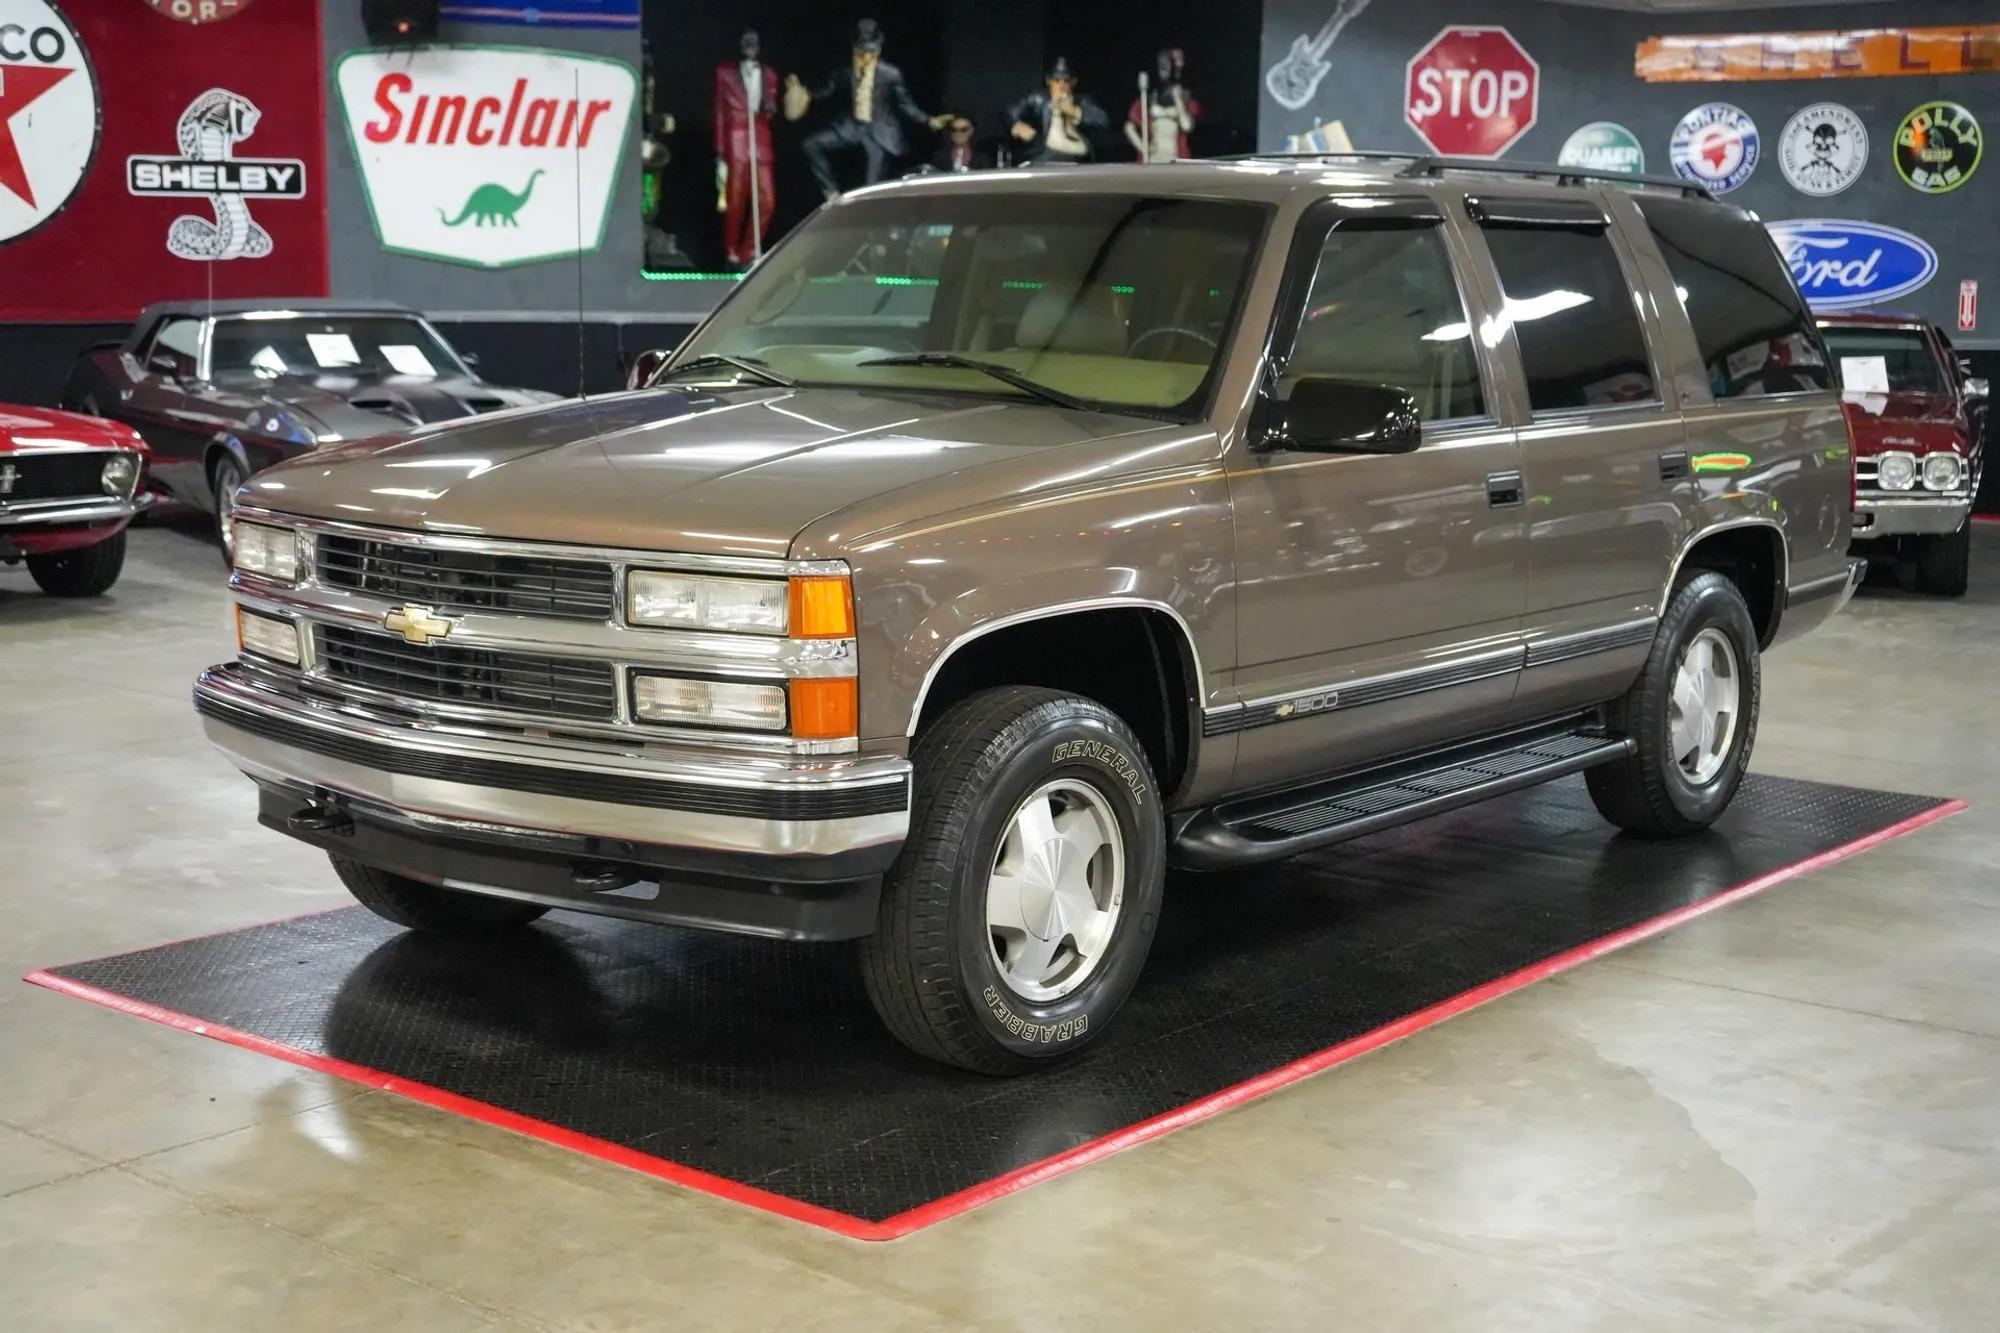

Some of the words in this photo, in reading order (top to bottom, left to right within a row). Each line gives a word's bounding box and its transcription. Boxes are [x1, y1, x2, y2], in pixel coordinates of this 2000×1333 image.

[0, 24, 65, 63] CO
[1692, 29, 1993, 72] SHELL
[364, 72, 612, 149] Sinclair
[1417, 68, 1529, 119] STOP
[1677, 106, 1756, 141] PONTIAC
[1899, 107, 1978, 147] POLLY
[1565, 147, 1639, 166] QUAKER
[135, 163, 295, 192] SHELBY
[1785, 236, 1883, 288] Ford
[1294, 691, 1339, 714] 1500
[1052, 740, 1147, 805] GENERAL
[982, 985, 1089, 1043] GRABBER
